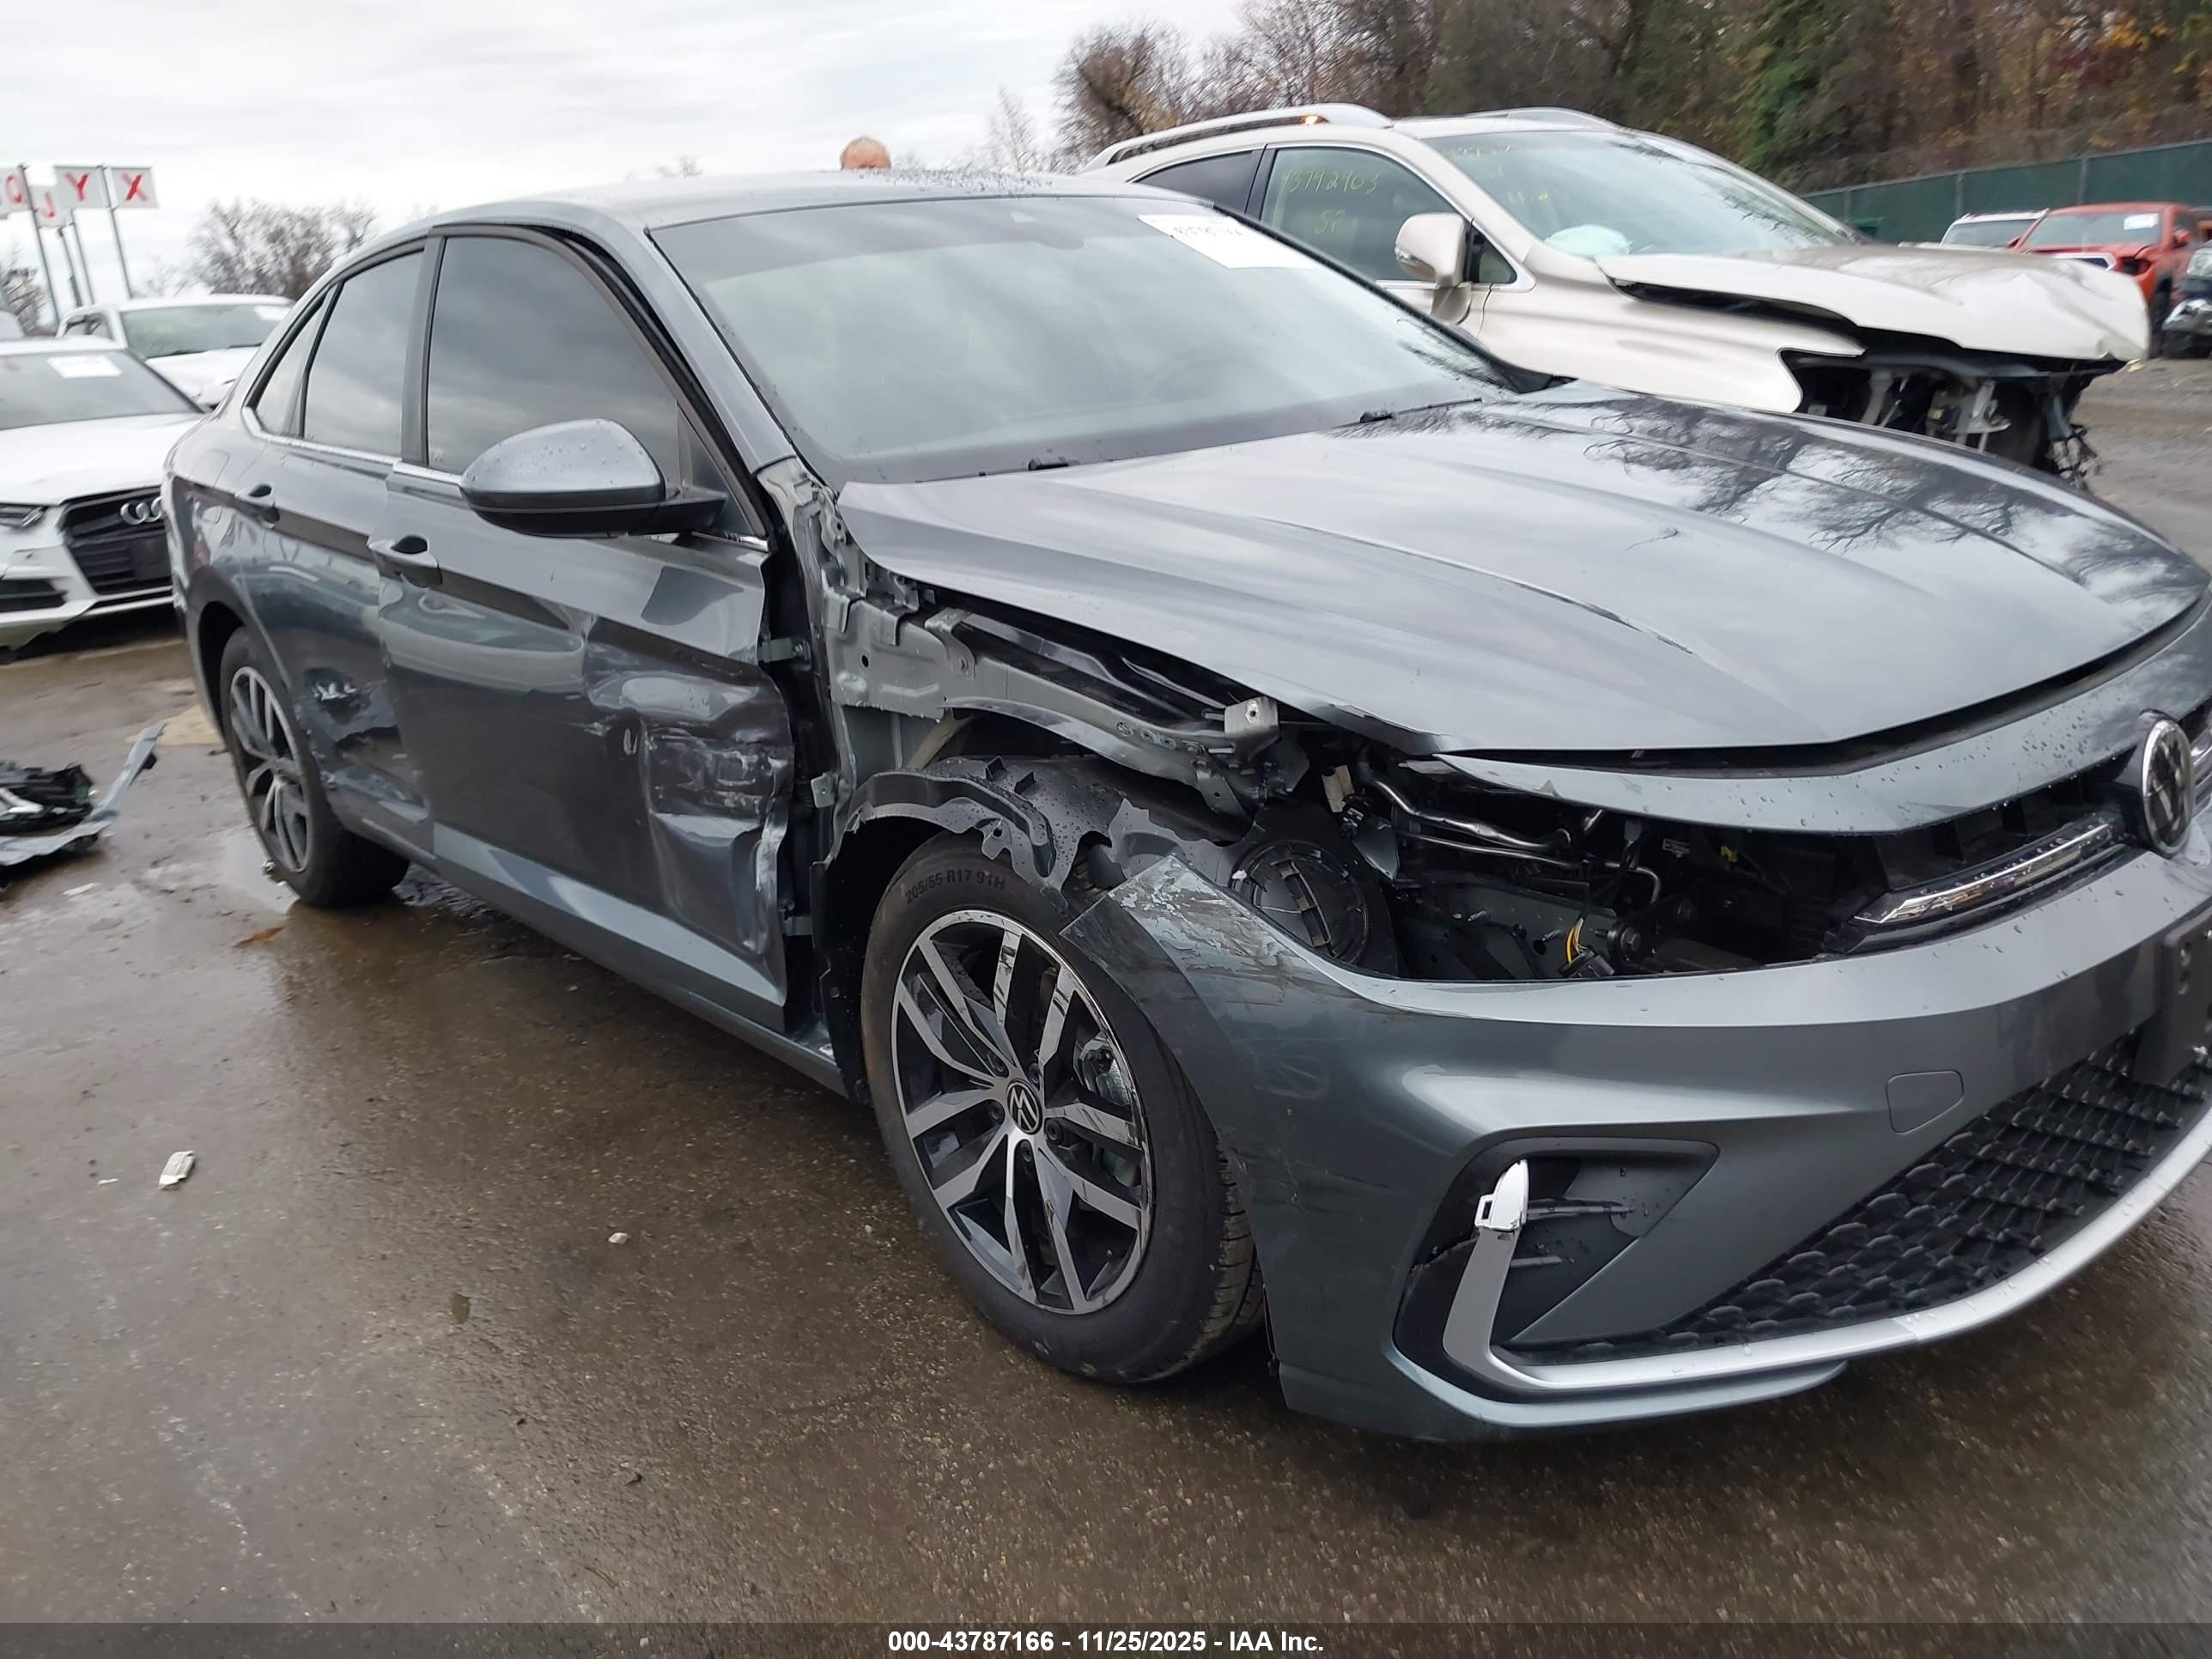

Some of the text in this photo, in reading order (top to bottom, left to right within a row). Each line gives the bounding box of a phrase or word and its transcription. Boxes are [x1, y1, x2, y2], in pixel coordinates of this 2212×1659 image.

[64, 172, 89, 202] Y
[121, 173, 149, 203] X
[946, 869, 973, 884] R17
